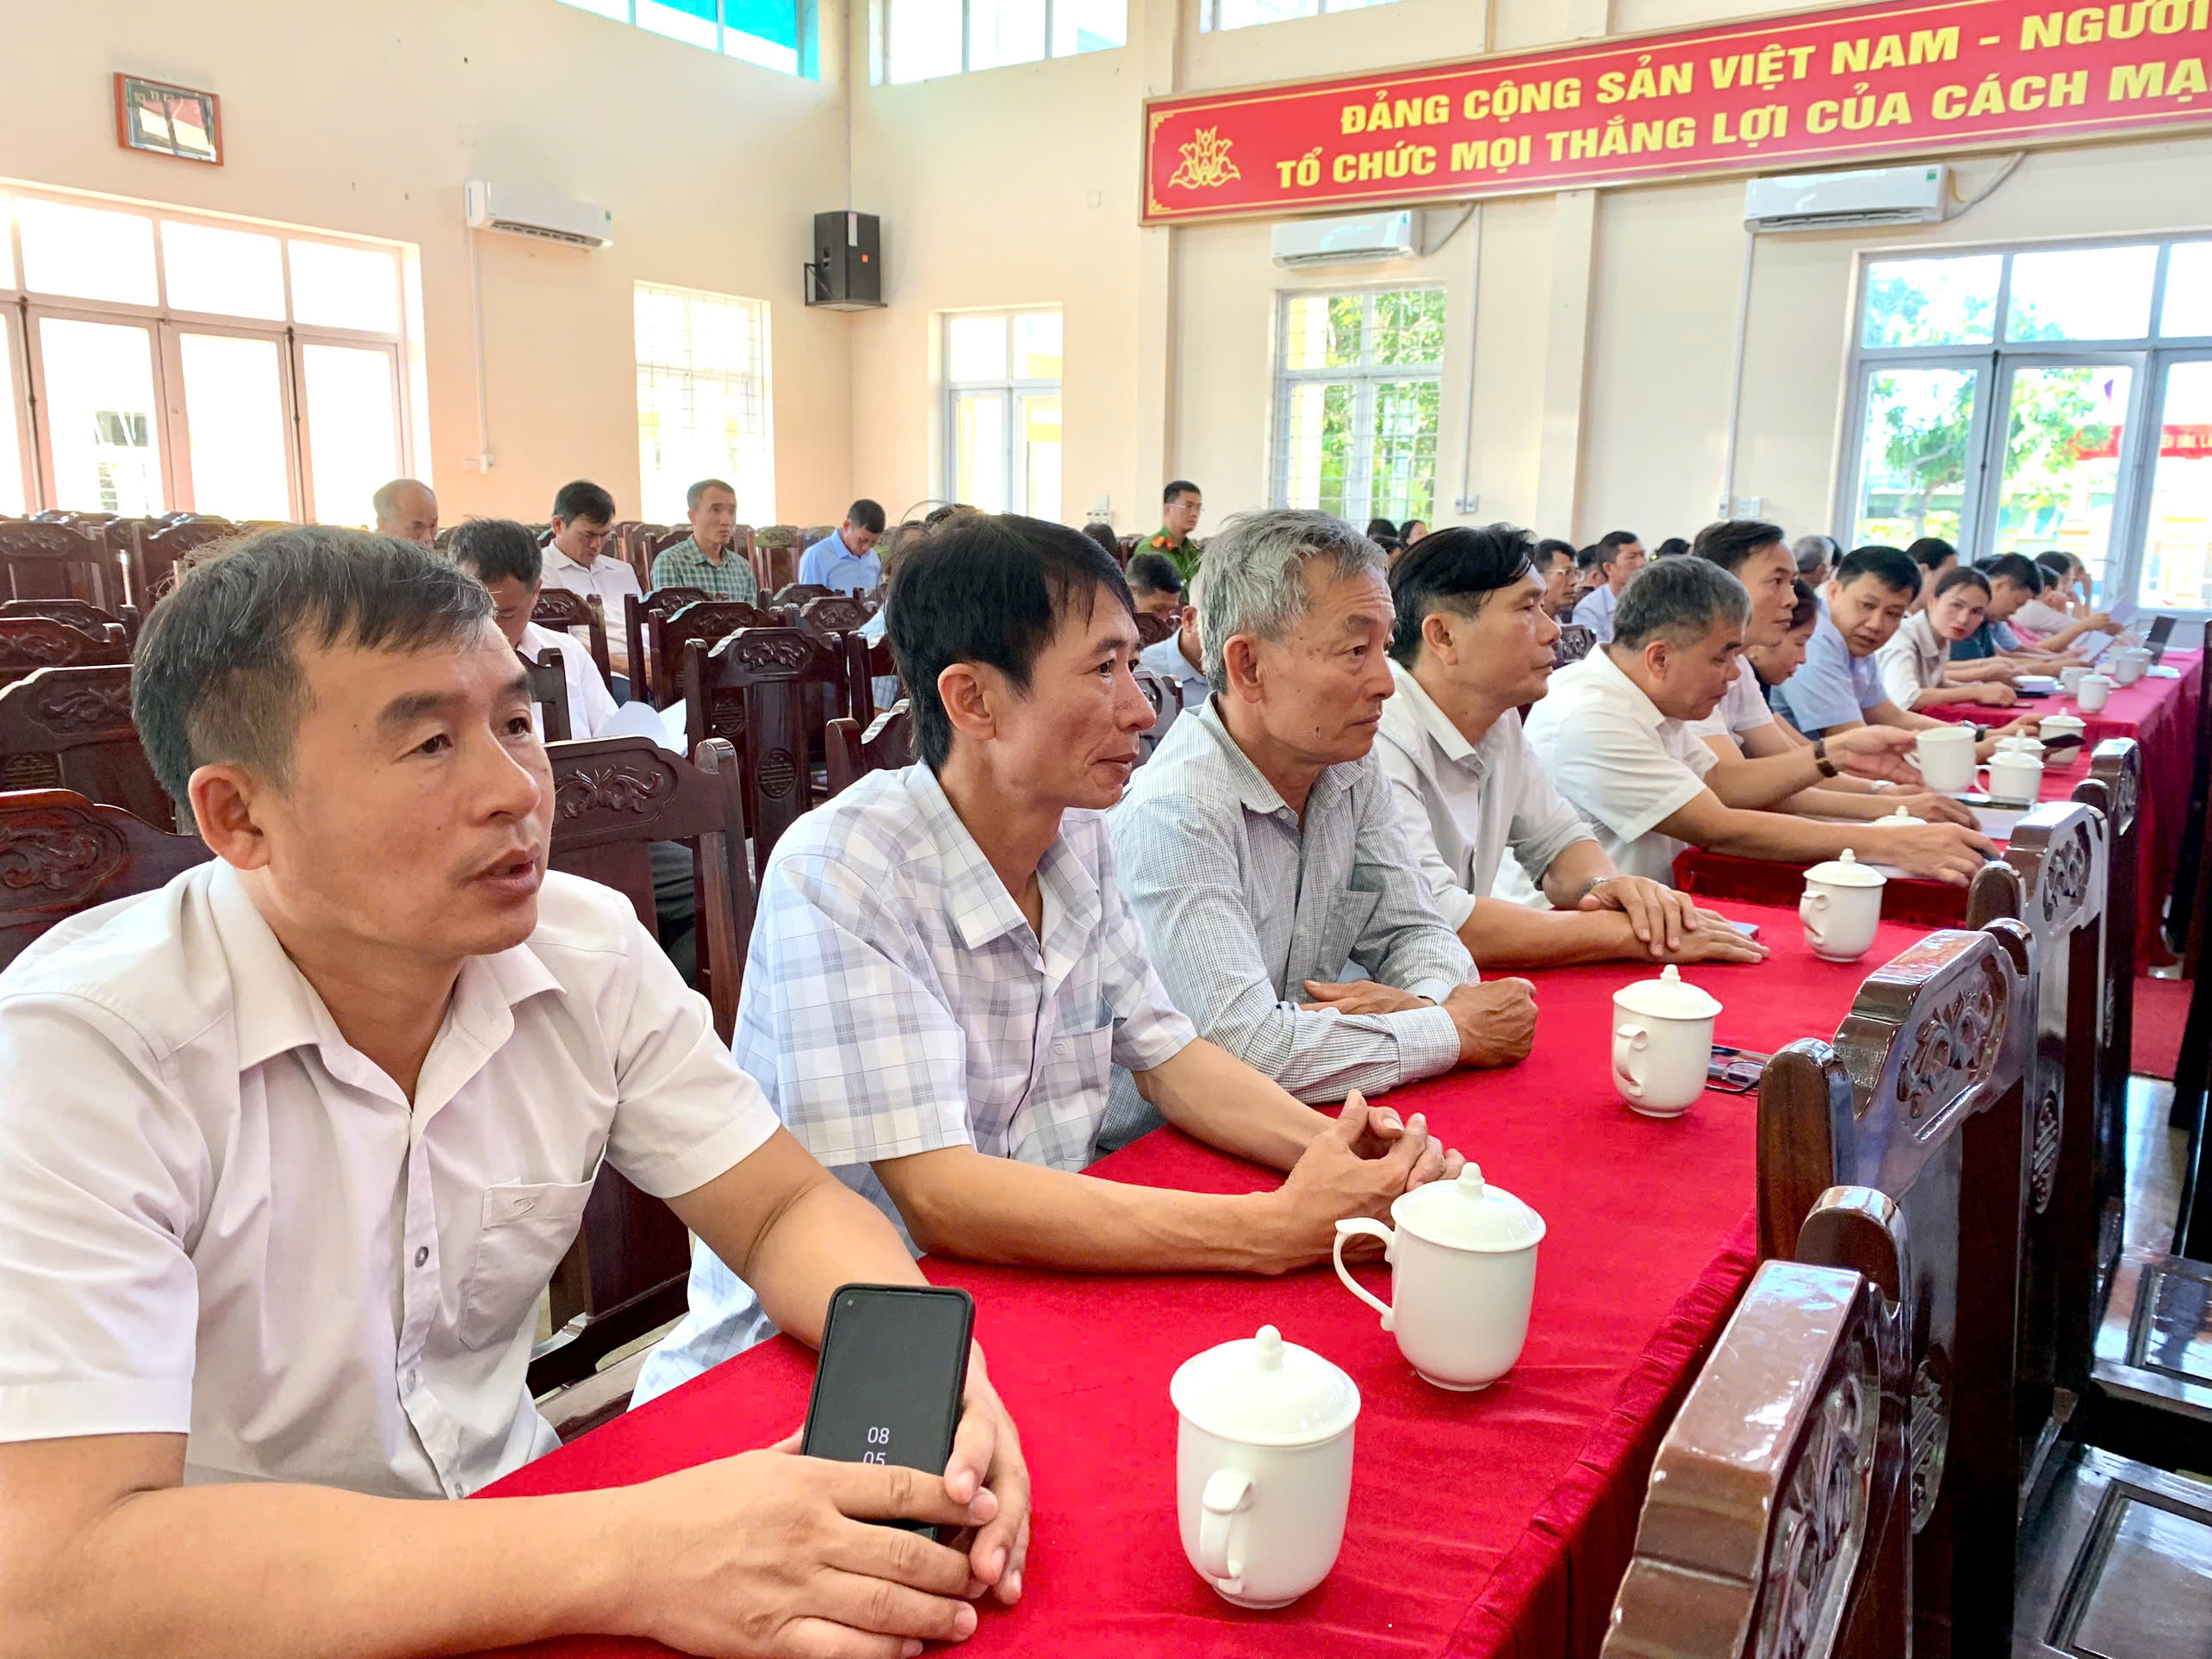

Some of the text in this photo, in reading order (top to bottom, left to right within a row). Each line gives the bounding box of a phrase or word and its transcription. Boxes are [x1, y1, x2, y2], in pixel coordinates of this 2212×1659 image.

[1276, 58, 2212, 189] TỔ CHỨC MỌI THẮNG LỢI CỦA CÁCH MẠ
[1340, 90, 1450, 134] ĐẢNG
[1463, 80, 1581, 122] CỘNG
[1596, 54, 1694, 104] SẢN
[1709, 43, 1816, 90] VIỆT
[1830, 27, 1960, 74] NAM
[867, 1426, 890, 1445] 08
